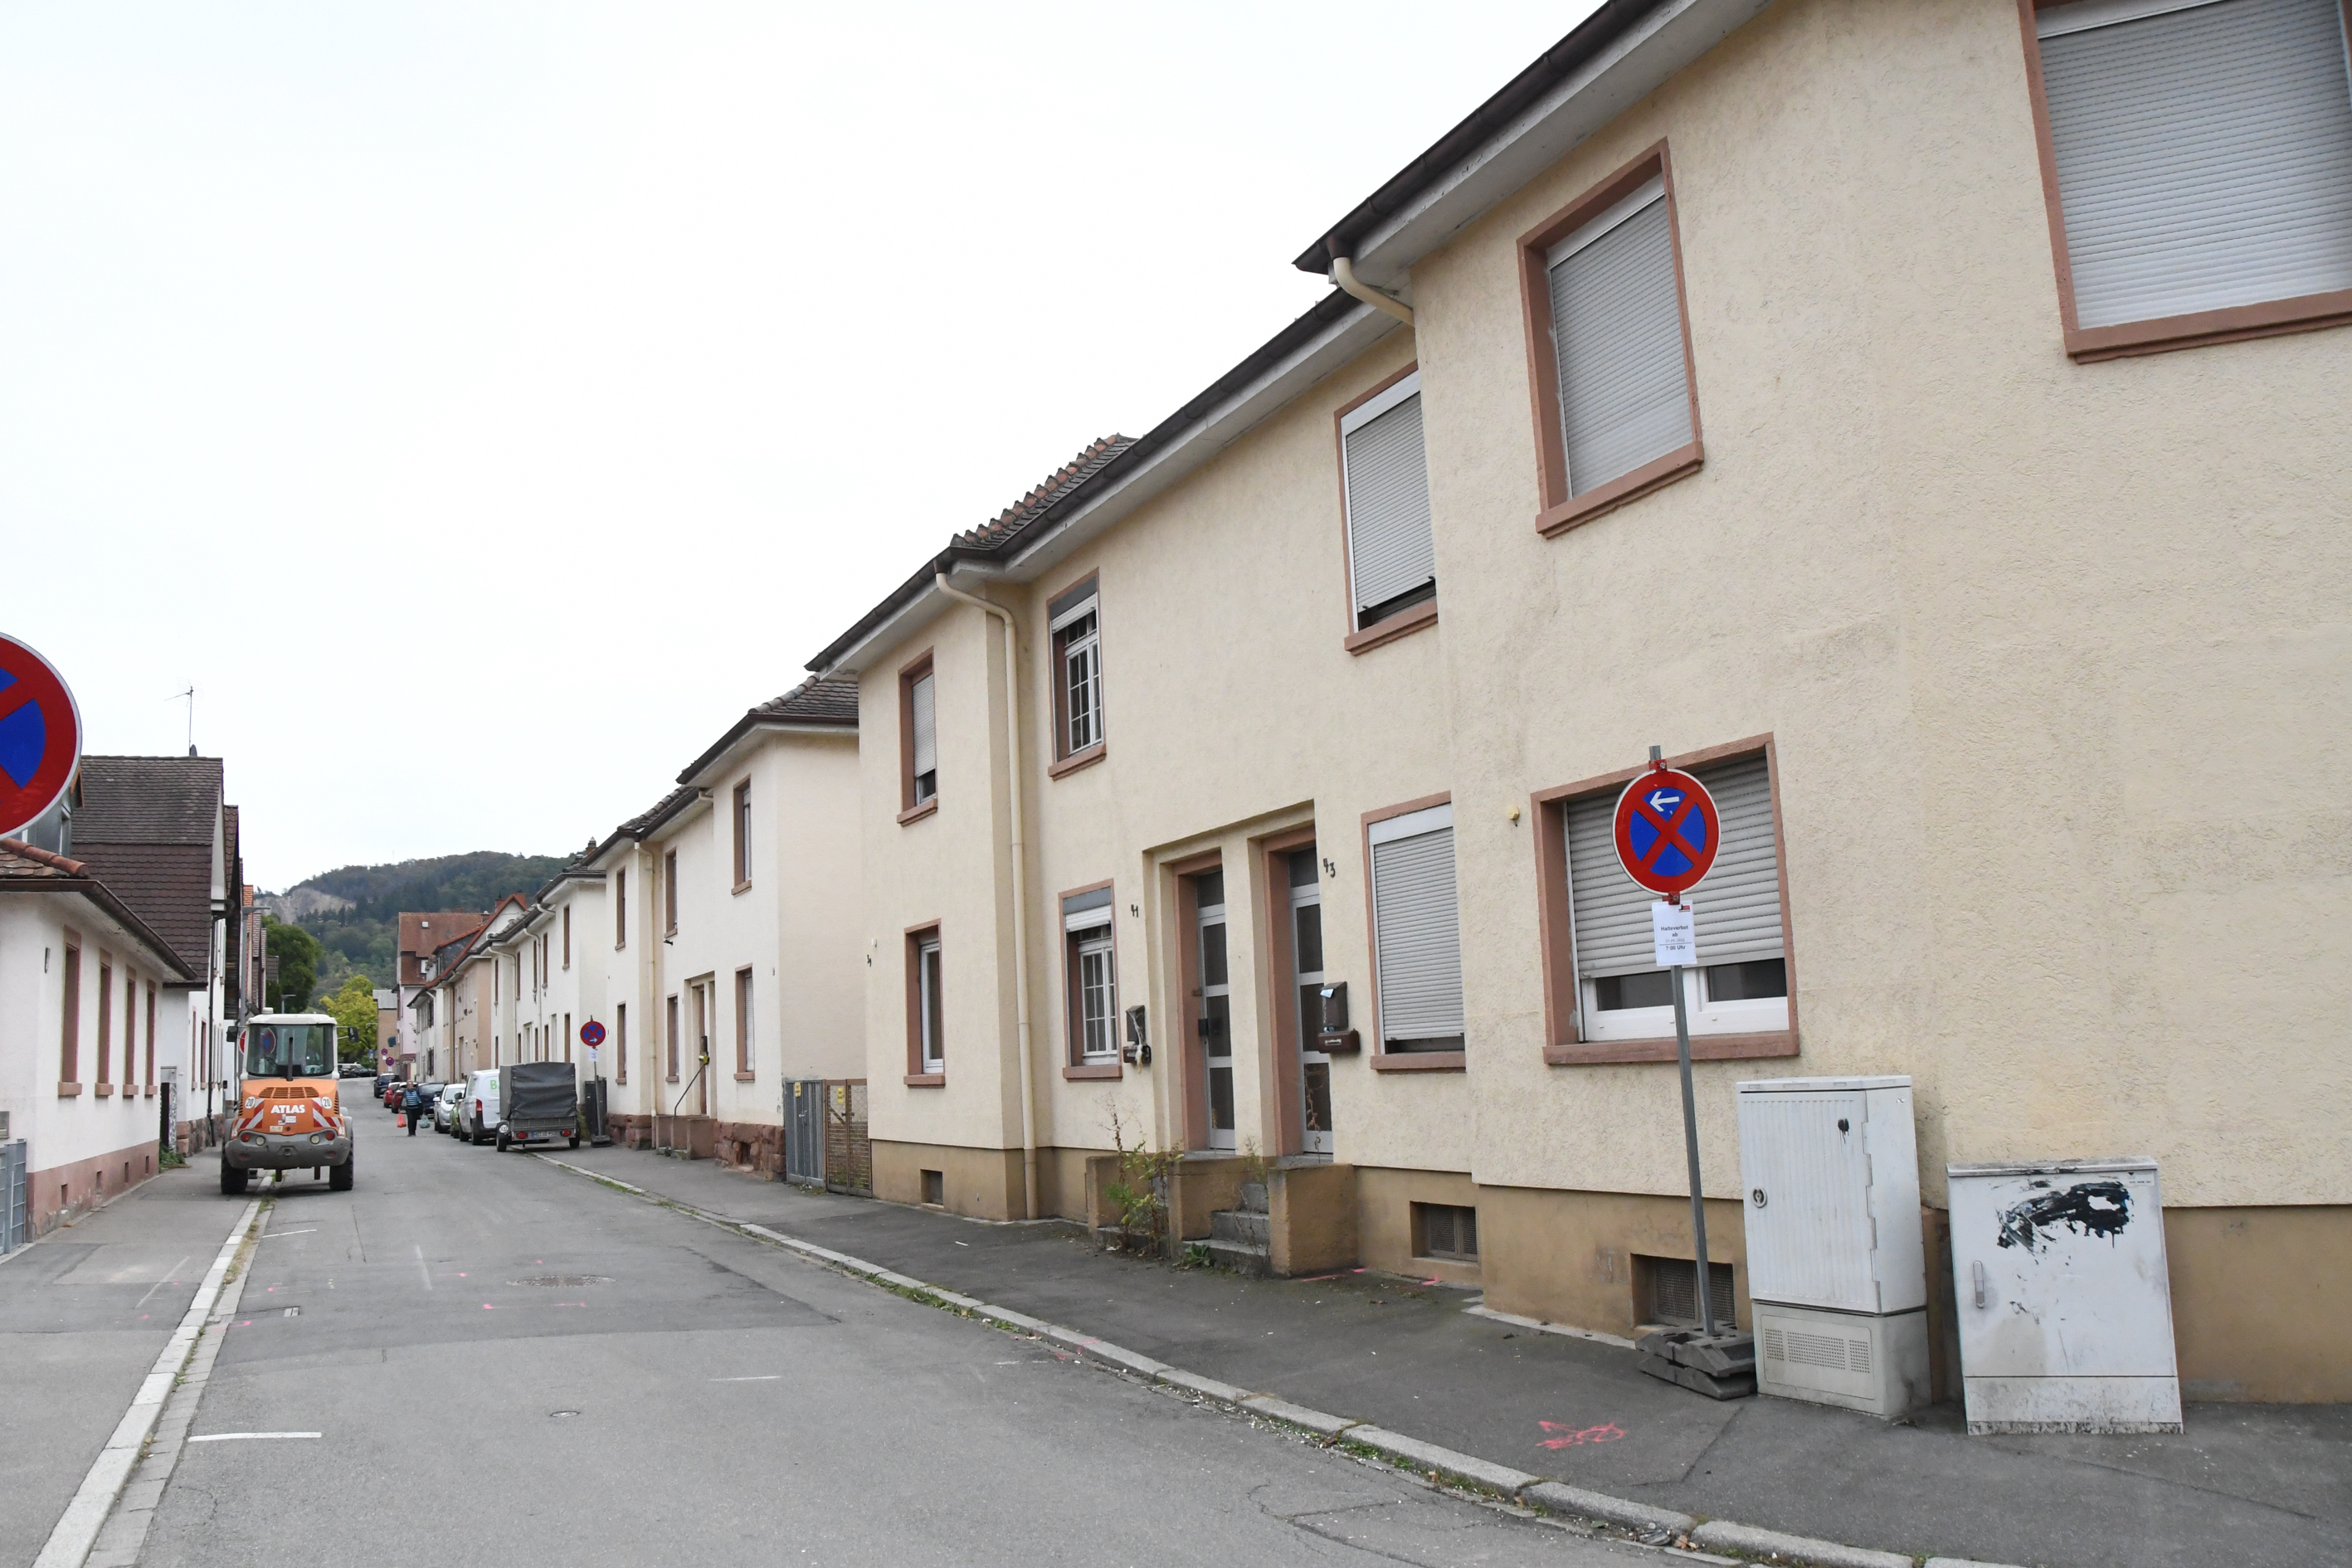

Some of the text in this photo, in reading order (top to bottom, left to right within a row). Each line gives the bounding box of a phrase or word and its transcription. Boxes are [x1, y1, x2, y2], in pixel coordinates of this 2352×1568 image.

[1323, 858, 1336, 879] 43
[246, 1098, 255, 1108] 20
[323, 1098, 331, 1108] 20
[270, 1104, 305, 1113] ATLAS
